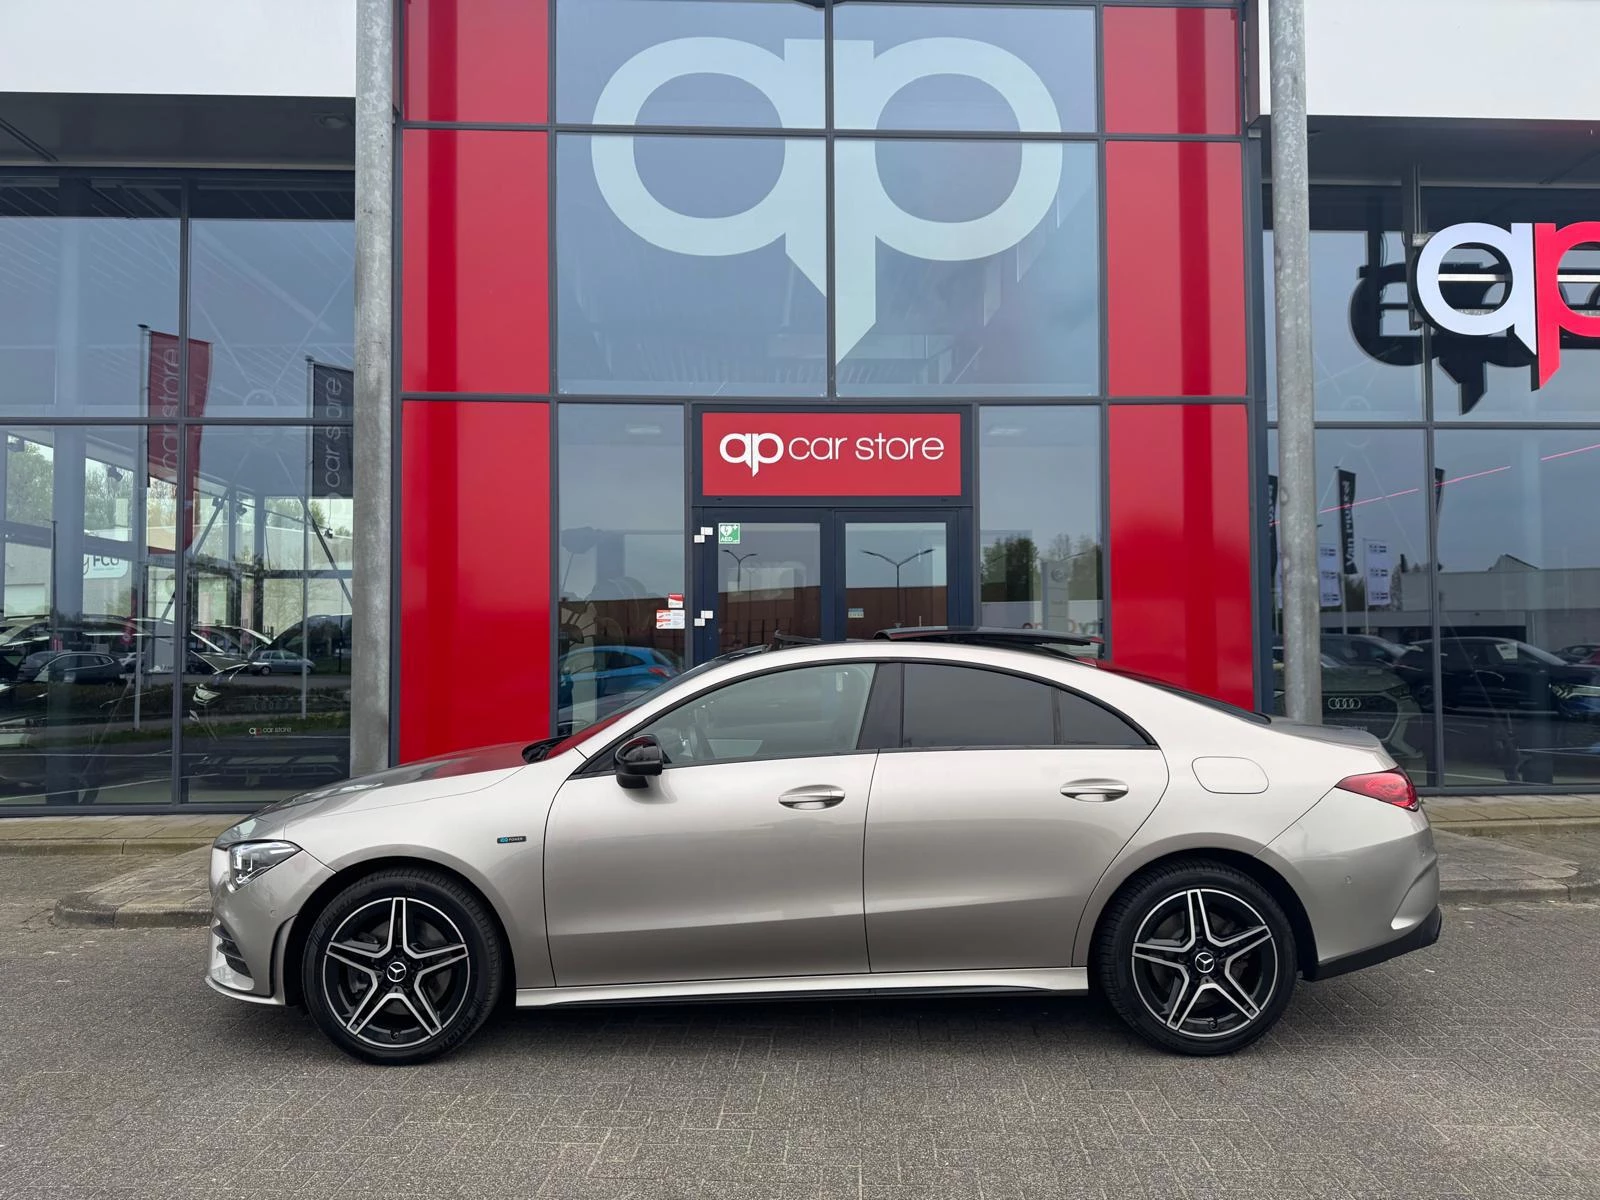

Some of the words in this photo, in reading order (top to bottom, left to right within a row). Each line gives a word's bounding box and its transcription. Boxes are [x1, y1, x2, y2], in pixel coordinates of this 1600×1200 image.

[325, 376, 342, 441] sore
[325, 443, 341, 488] car
[719, 432, 784, 477] ap
[788, 436, 848, 461] car
[855, 432, 945, 461] store
